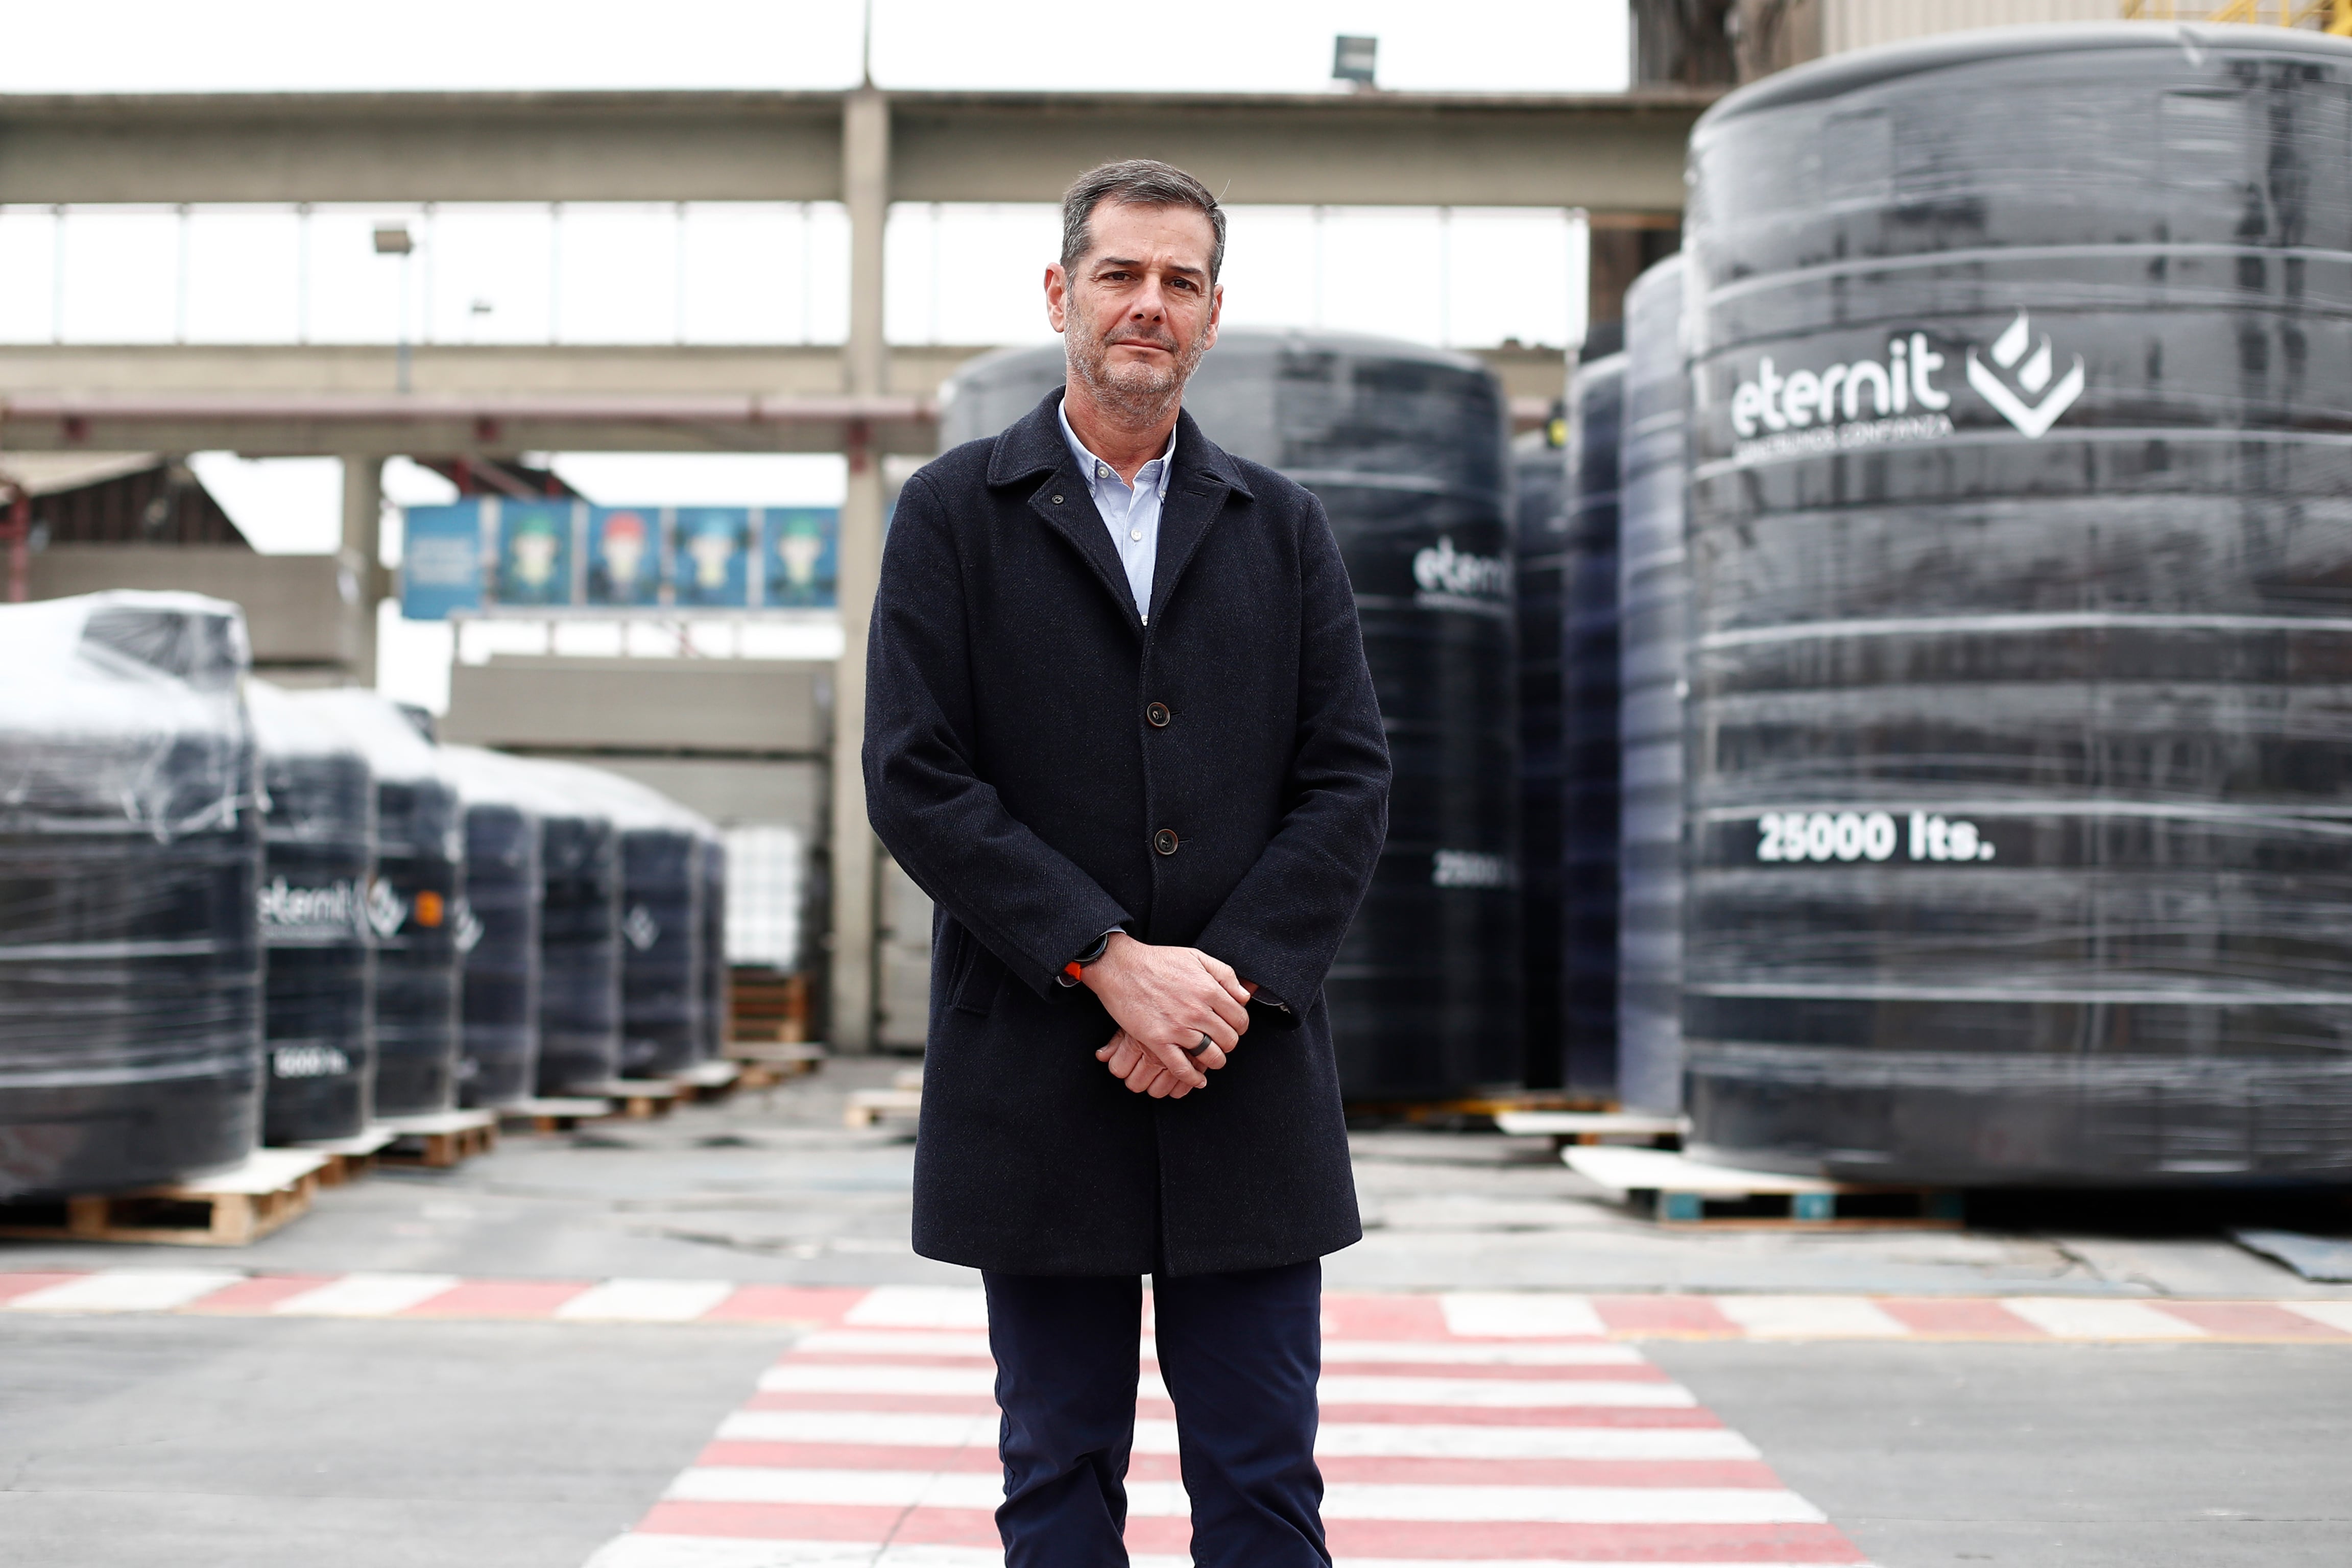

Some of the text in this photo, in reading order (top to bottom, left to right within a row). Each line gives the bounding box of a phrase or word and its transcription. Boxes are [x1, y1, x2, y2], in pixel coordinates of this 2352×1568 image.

[1731, 331, 1951, 437] eternit
[1757, 809, 1996, 862] 25000 lts.
